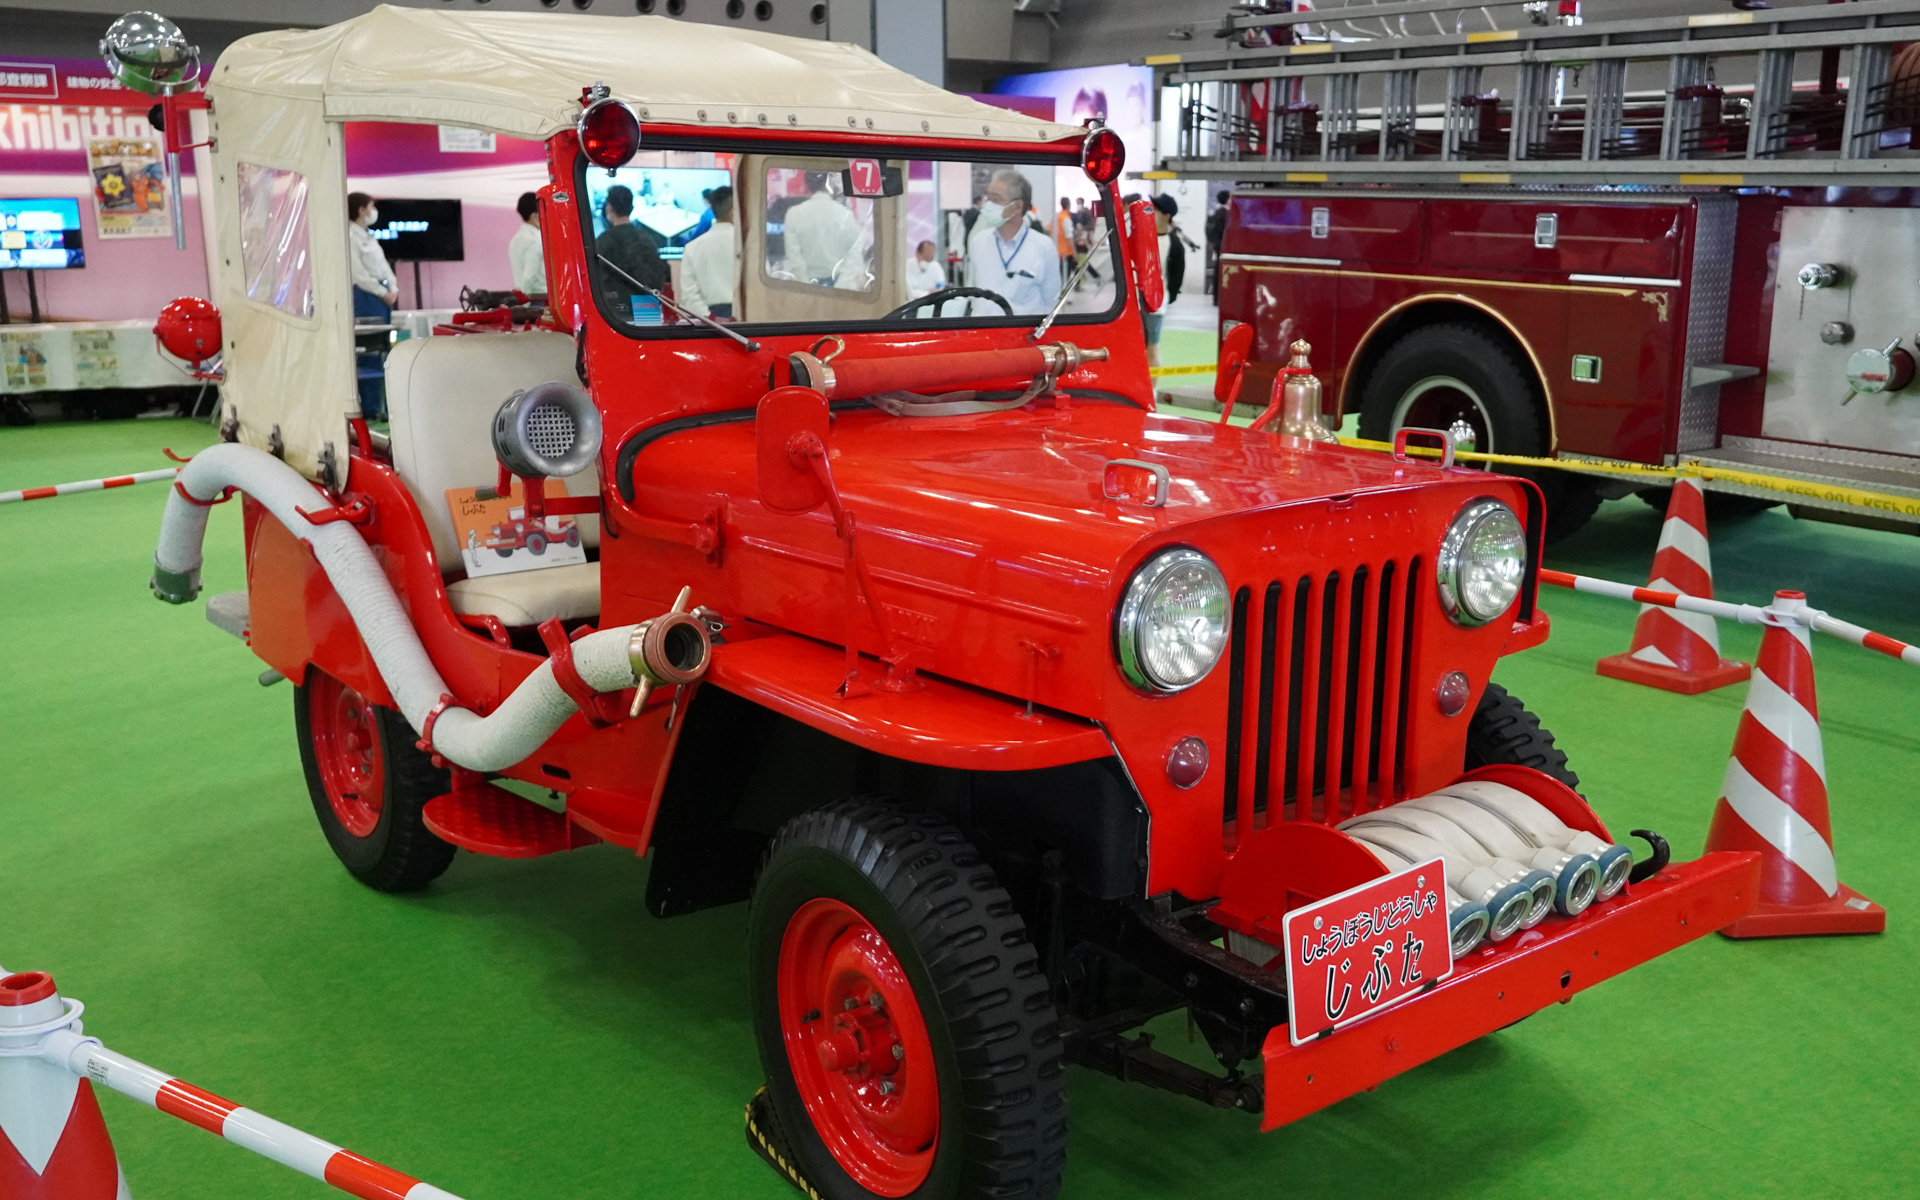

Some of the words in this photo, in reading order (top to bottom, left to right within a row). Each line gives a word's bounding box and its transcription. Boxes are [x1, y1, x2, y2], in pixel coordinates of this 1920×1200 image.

[856, 162, 873, 187] 7
[1302, 890, 1437, 965] しょうぼうじどうしゃ
[1326, 931, 1424, 1020] じぷた
